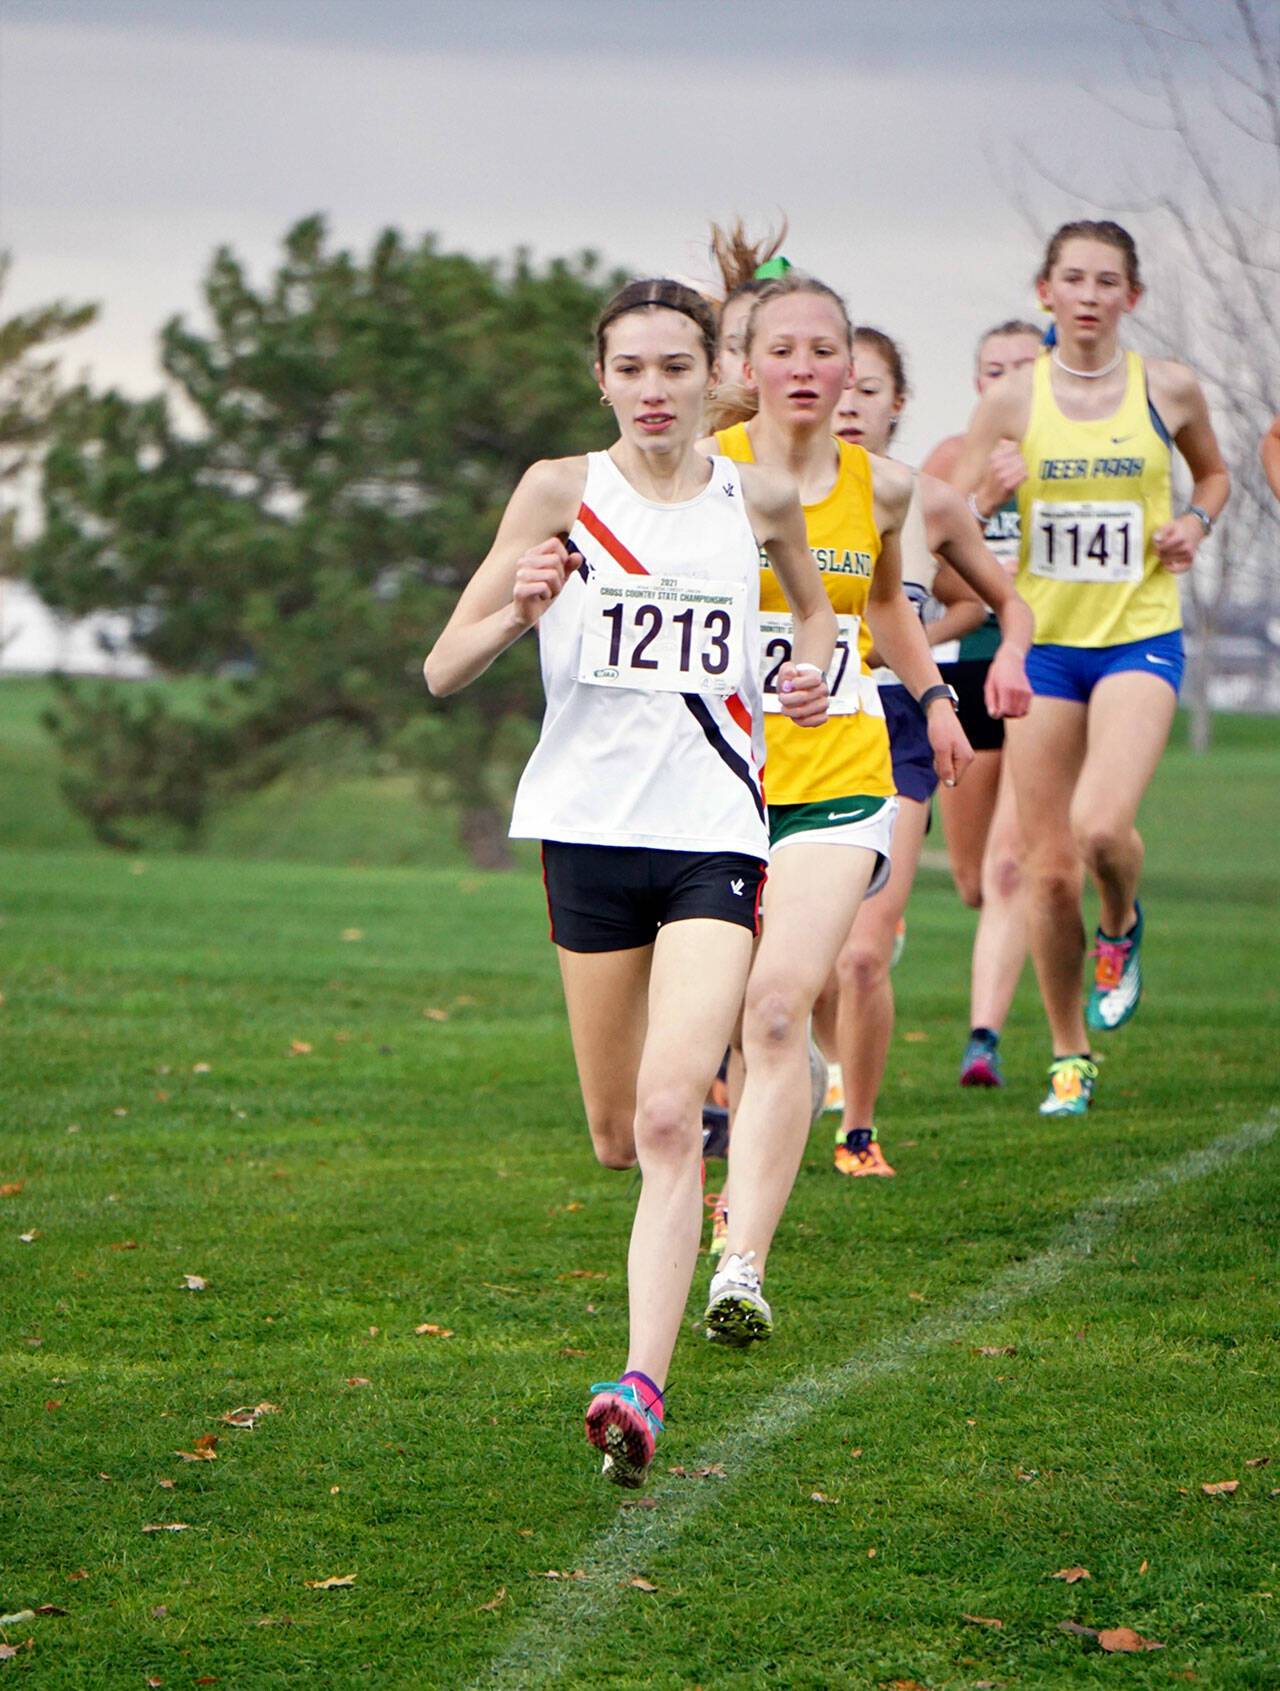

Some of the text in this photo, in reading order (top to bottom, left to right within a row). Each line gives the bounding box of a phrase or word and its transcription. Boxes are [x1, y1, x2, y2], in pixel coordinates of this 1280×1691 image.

[1041, 522, 1129, 566] 1141
[600, 586, 623, 597] CROSS
[625, 589, 656, 599] COUNTRY
[657, 591, 678, 601] STATE
[680, 593, 733, 605] CHAMPIONSHIPS
[660, 578, 677, 586] 2021
[602, 602, 731, 675] 1213
